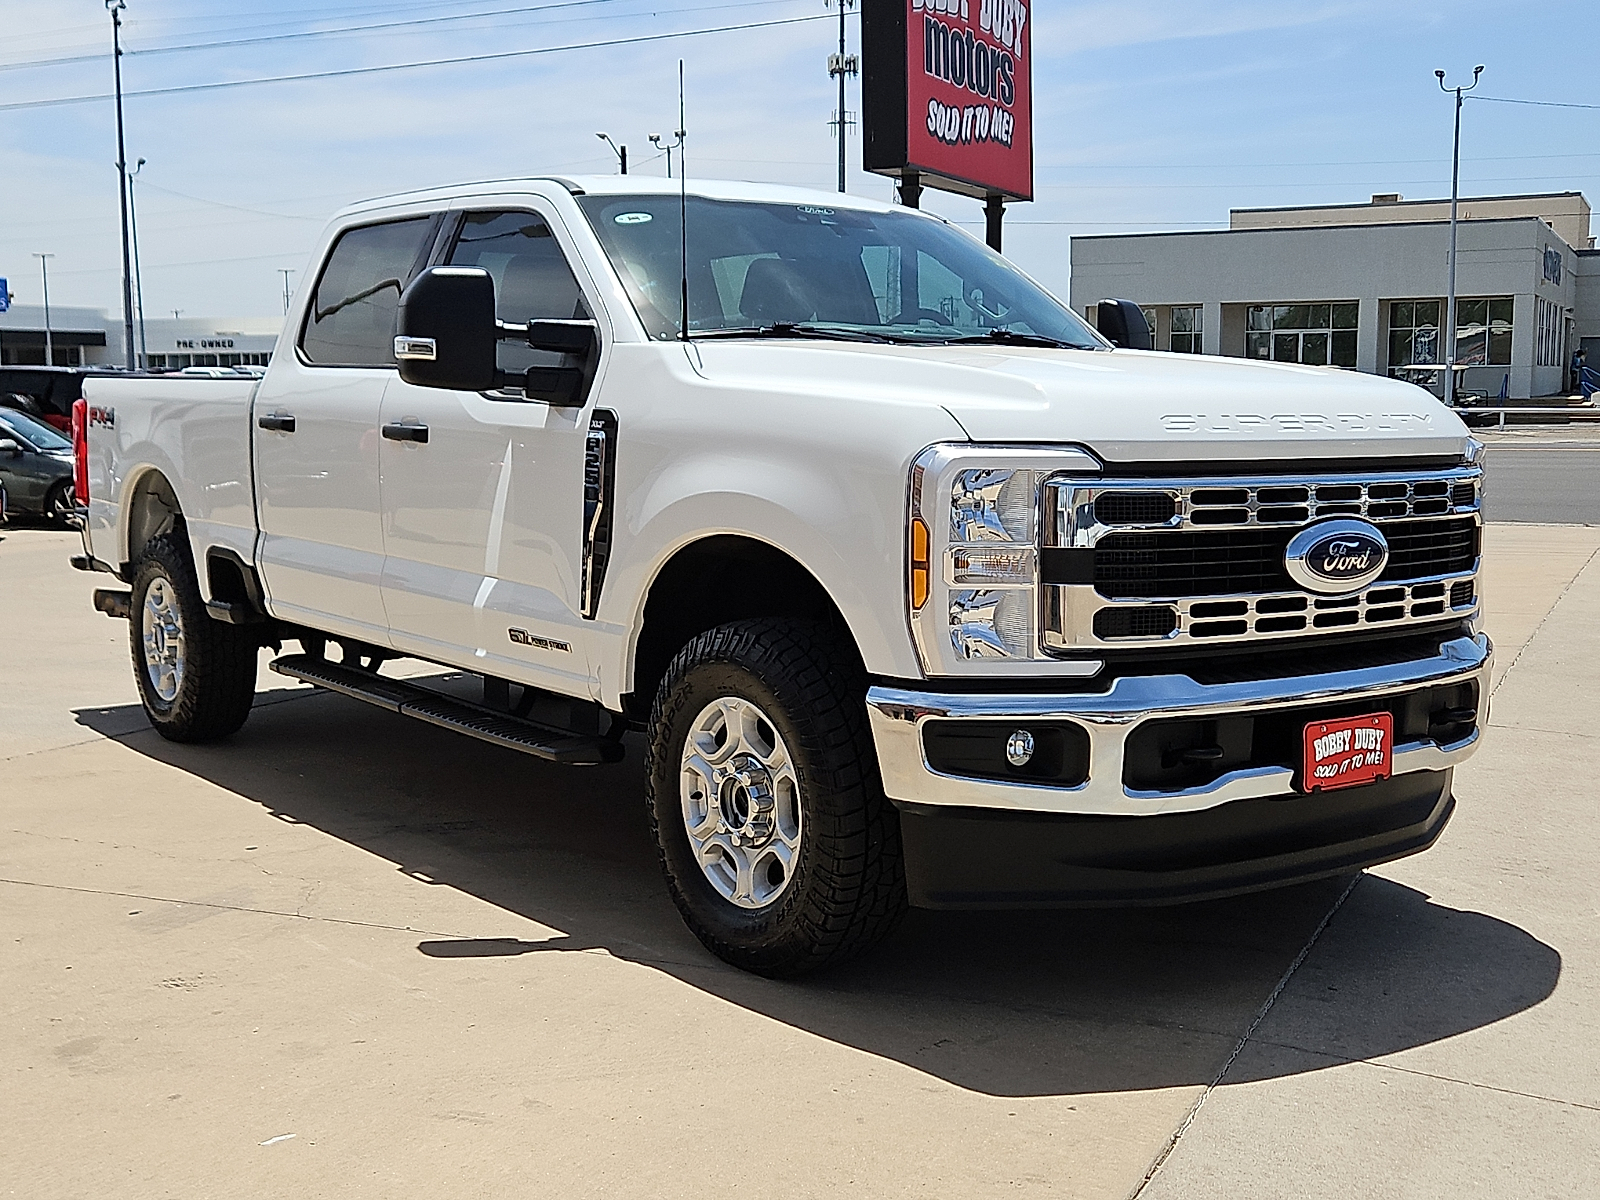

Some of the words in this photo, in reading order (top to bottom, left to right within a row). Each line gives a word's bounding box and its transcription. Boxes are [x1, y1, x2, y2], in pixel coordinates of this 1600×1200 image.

[923, 13, 1015, 107] motors
[927, 98, 961, 145] SOLD
[961, 106, 976, 144] IT
[974, 104, 989, 143] TO
[989, 104, 1014, 148] ME!
[1160, 413, 1336, 433] SUPER
[1336, 413, 1435, 433] DUTY
[1323, 540, 1373, 572] Ford
[1313, 729, 1352, 762] BOBBY
[1354, 728, 1385, 751] DUBY
[1313, 763, 1339, 778] SOLD
[1339, 758, 1351, 775] IT
[1351, 753, 1364, 770] TO
[1364, 751, 1385, 766] ME!
